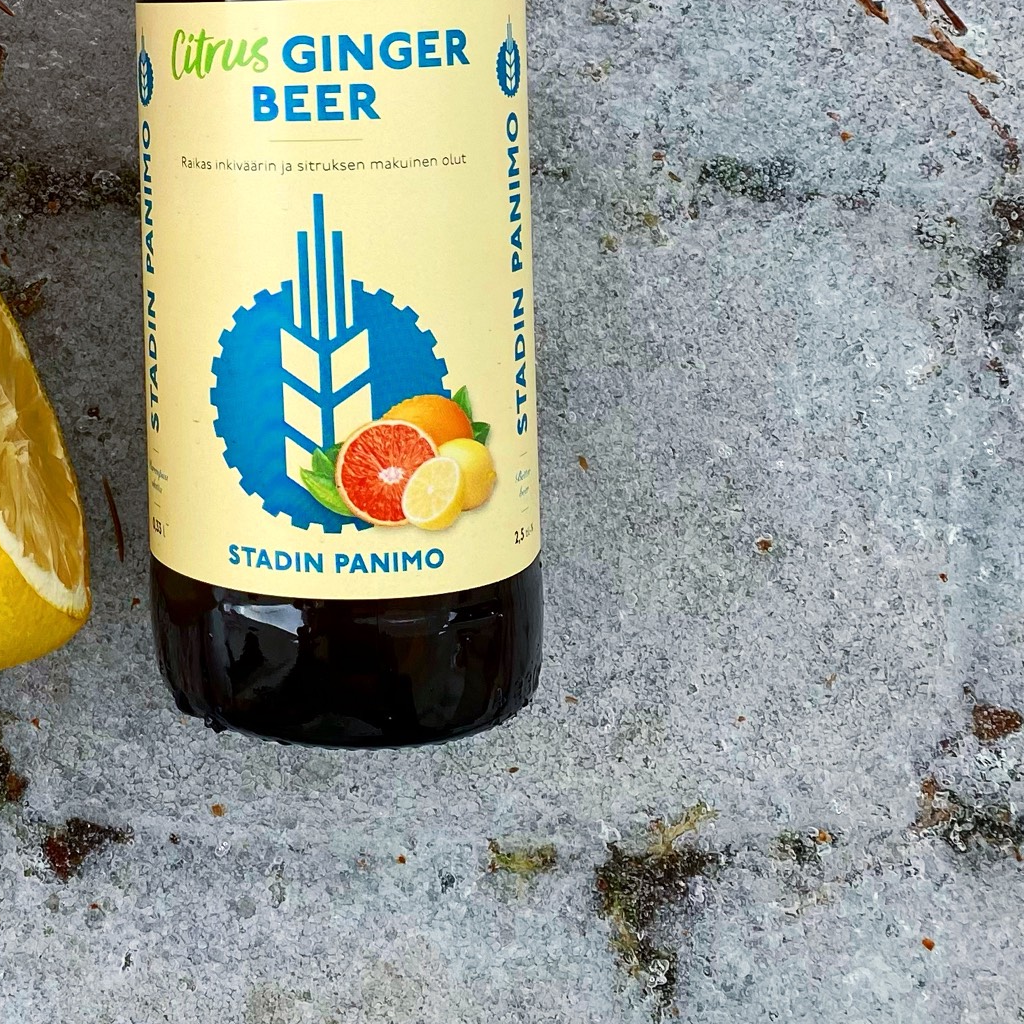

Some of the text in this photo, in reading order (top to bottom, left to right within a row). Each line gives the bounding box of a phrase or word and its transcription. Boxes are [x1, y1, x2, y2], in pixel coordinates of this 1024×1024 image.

[171, 28, 471, 80] Citrus GINGER
[252, 83, 381, 122] BEER
[181, 153, 467, 175] Raikas inkiväärin ja sitruksen makuinen olut
[142, 120, 160, 434] STADIN PANIMO
[506, 111, 528, 436] STADIN PANIMO
[514, 527, 525, 545] 2,5
[229, 544, 445, 574] STADIN PANIMO
